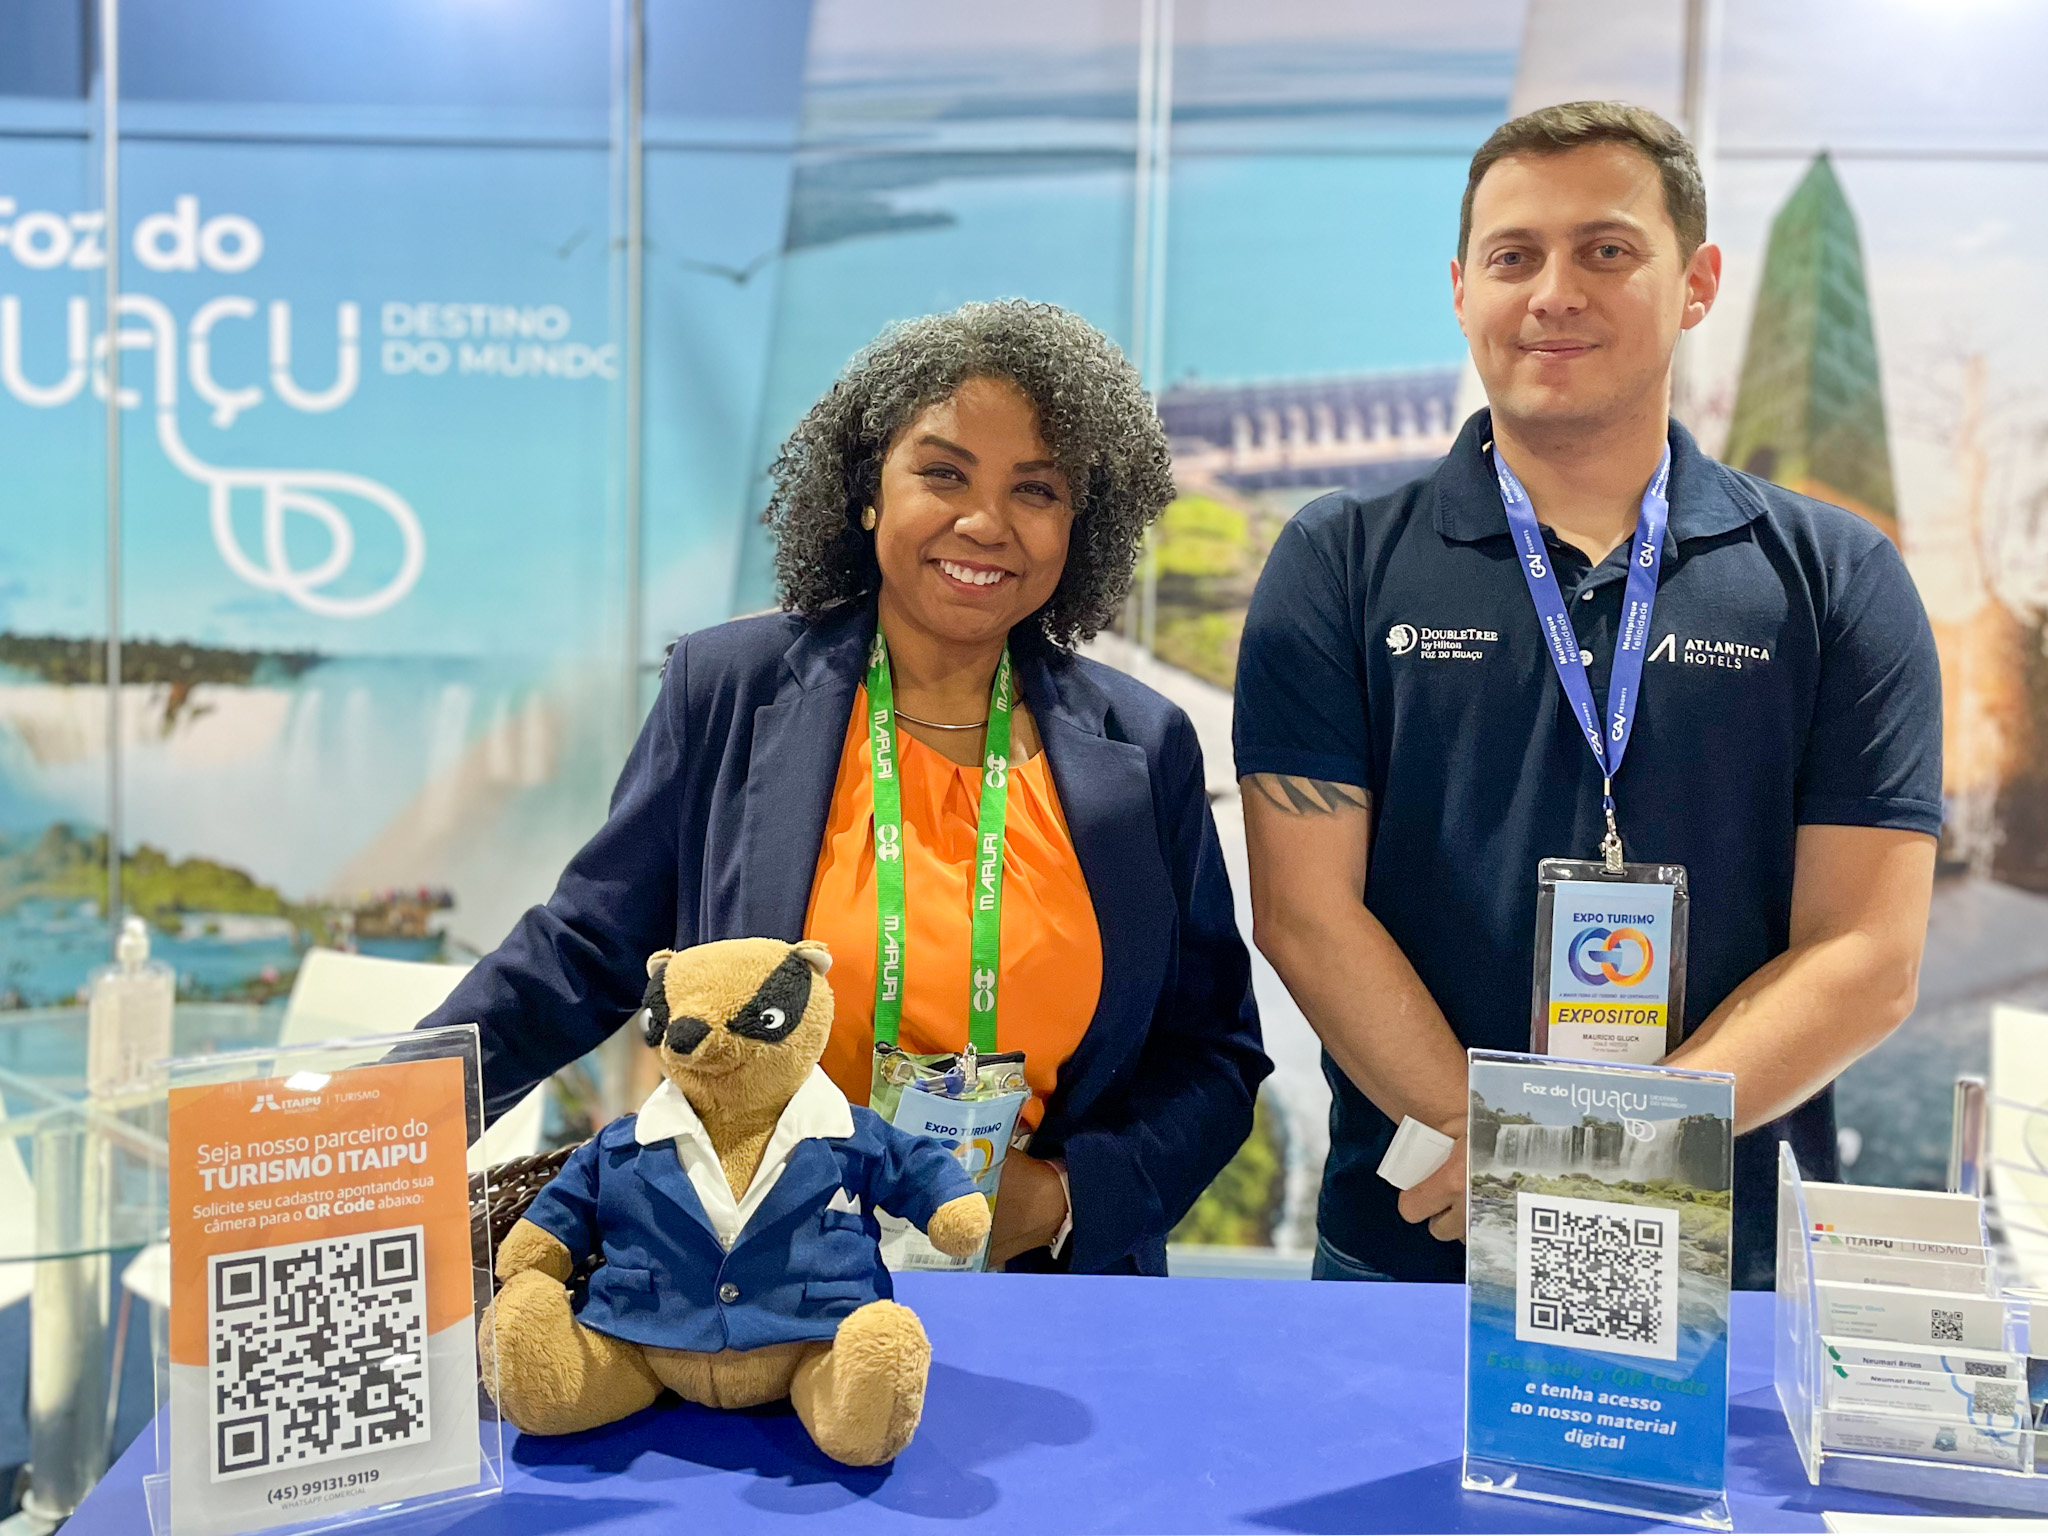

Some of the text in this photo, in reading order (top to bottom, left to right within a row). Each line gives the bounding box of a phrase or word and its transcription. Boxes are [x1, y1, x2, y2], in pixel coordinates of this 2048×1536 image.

[132, 195, 264, 272] do
[380, 301, 571, 342] DESTINO
[380, 340, 450, 376] DO
[1546, 615, 1568, 665] Multiplique
[1556, 613, 1578, 663] felicidade
[1622, 601, 1639, 651] Multiplique
[1631, 602, 1649, 651] felicidade
[1420, 651, 1483, 661] FOZ DO IGUAÇU
[1421, 640, 1462, 651] by Hilton
[1684, 638, 1770, 661] ATLANTICA
[1684, 651, 1742, 670] HOTELS
[874, 709, 893, 779] MARURI
[979, 833, 998, 911] MARURI
[1573, 912, 1655, 925] EXPO TURISMO
[882, 915, 899, 1001] MARURI
[1557, 1008, 1659, 1025] EXPOSITOR
[1582, 1033, 1615, 1041] MAURICIO
[281, 1089, 380, 1110] ITAIPU TURISMO
[1523, 1082, 1648, 1122] Foz do Iguaçu
[197, 1118, 428, 1167] Seja nosso parceiro do
[924, 1121, 1002, 1137] EXPO TURISMO
[199, 1141, 428, 1192] TURISMO ITAIPU
[193, 1175, 434, 1220] Solicite seu cadastro apontando sua
[204, 1193, 425, 1234] câmera para o QR Code abaixo:
[1845, 1236, 1969, 1256] ITAIPU TURISMO
[1590, 1369, 1604, 1381] o
[1612, 1368, 1643, 1388] QR
[1862, 1356, 1922, 1368] Neumari Brites
[1870, 1375, 1906, 1384] Neumari
[1525, 1382, 1662, 1413] e tenha acesso
[1510, 1402, 1677, 1436] ao nosso material
[1564, 1428, 1626, 1450] digital
[267, 1469, 380, 1504] (45) 99131.9119
[281, 1487, 367, 1510] WHATSAPP COMERCIAL
